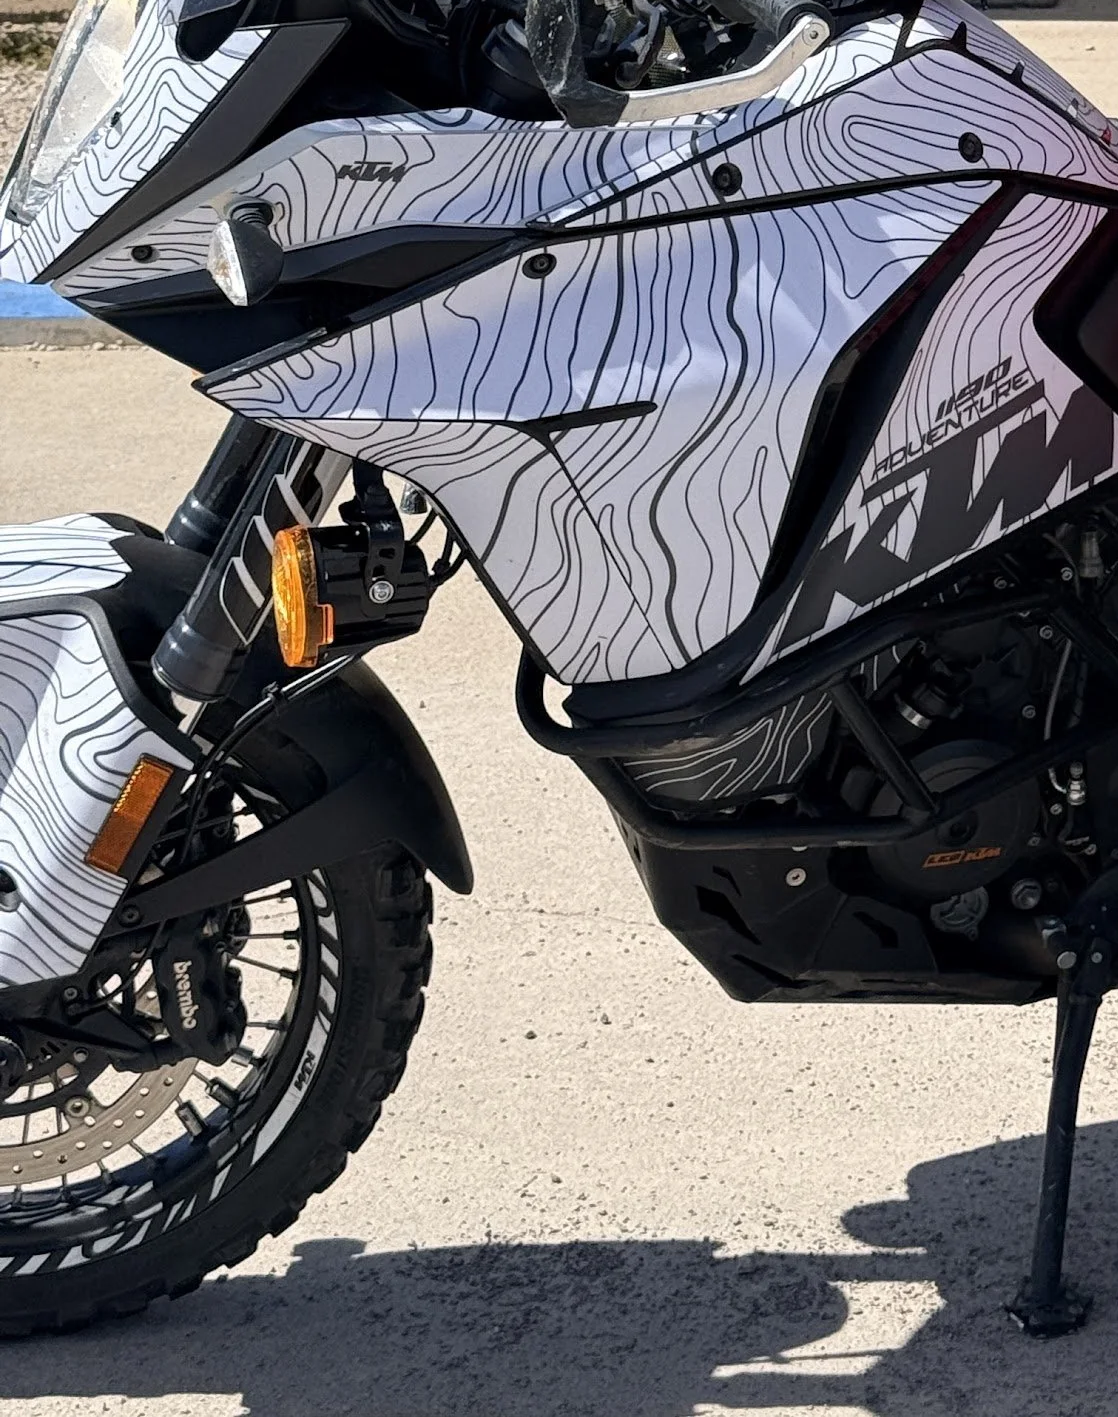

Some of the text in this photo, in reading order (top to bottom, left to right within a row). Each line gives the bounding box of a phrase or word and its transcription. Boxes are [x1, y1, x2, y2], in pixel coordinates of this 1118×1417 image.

[337, 161, 406, 183] KTM
[772, 378, 1114, 654] KTM
[173, 960, 200, 1030] brembo
[293, 1050, 316, 1092] KTM
